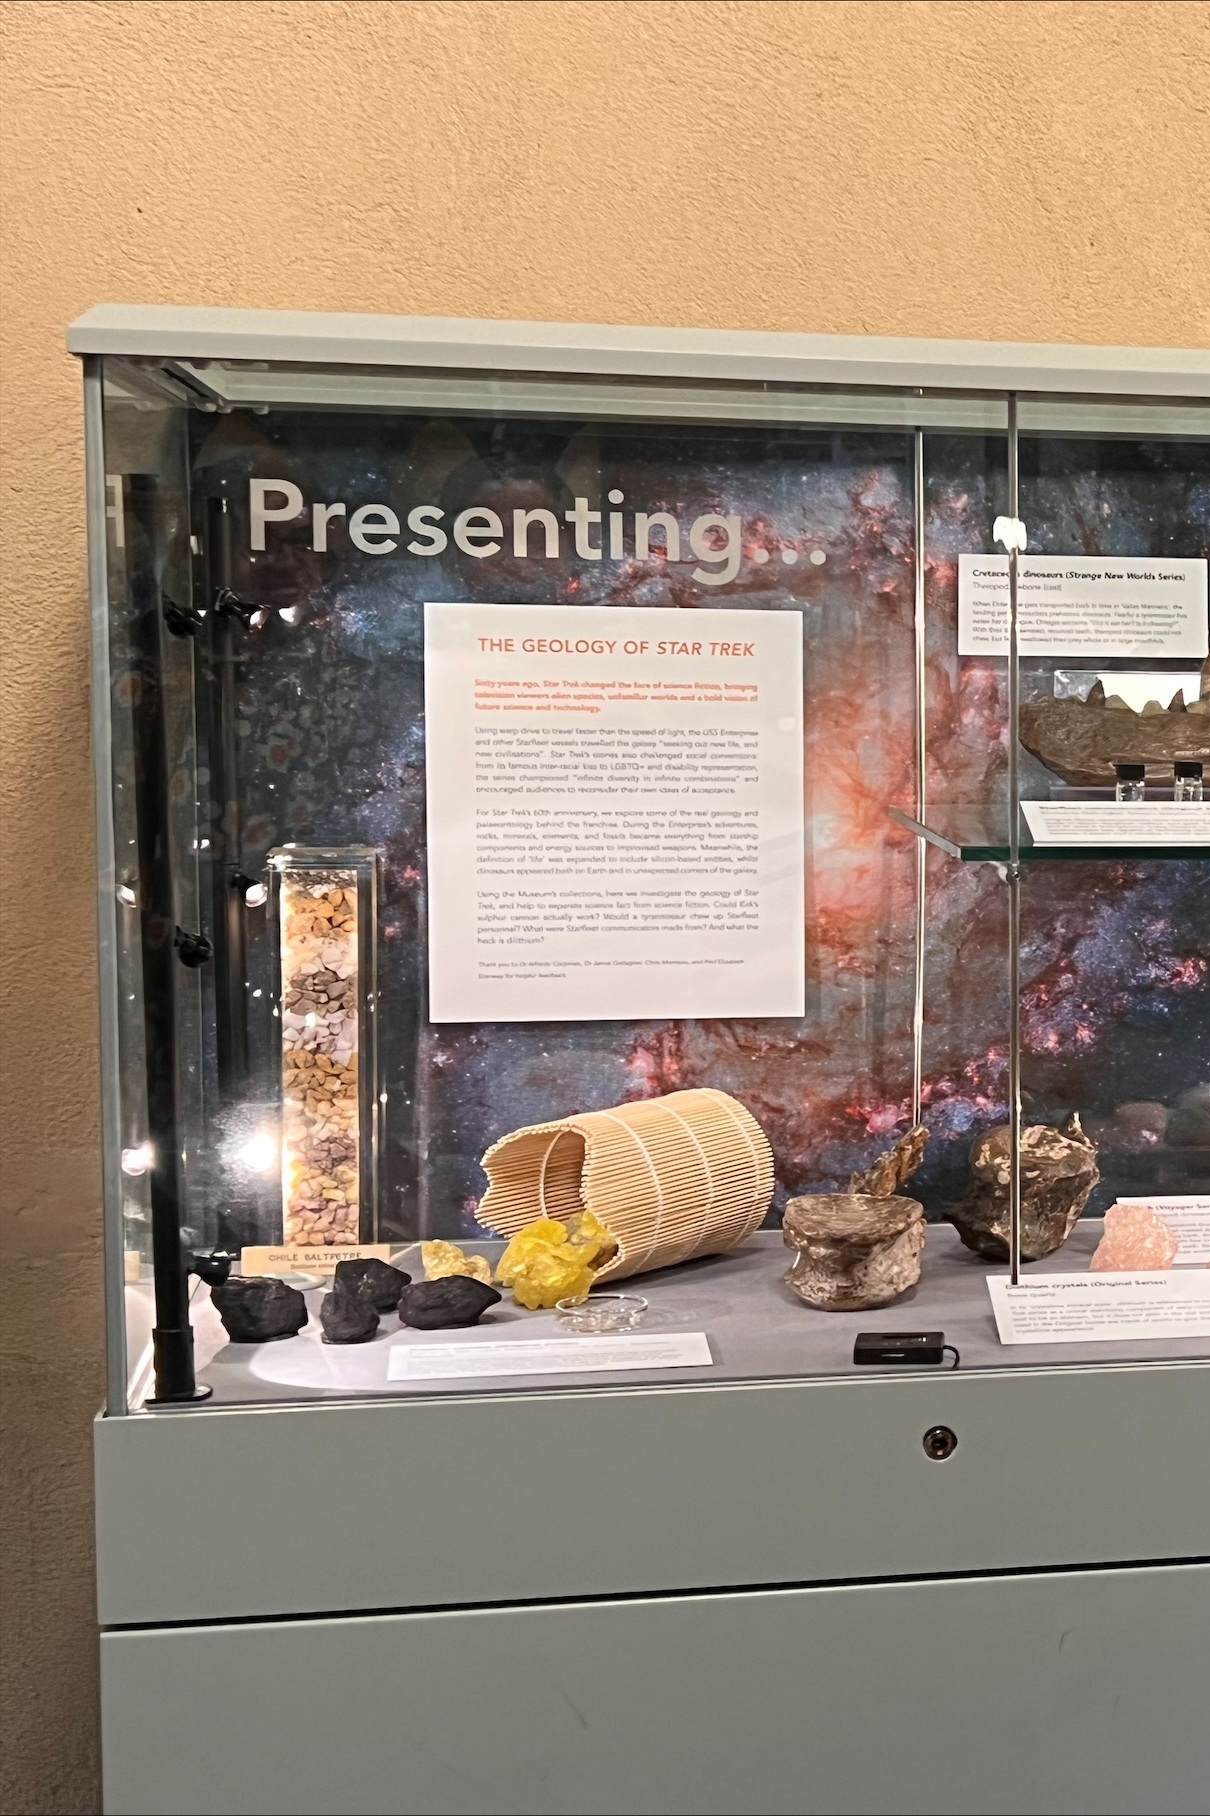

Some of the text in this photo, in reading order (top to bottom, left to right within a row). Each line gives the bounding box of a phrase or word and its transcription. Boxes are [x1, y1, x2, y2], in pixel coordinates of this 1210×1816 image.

[248, 478, 827, 585] Presenting...
[1023, 570, 1063, 579] dinosaurs
[1066, 571, 1102, 581] (Strange
[1105, 572, 1124, 580] New
[1127, 572, 1155, 580] Worlds
[1158, 572, 1186, 581] Series)
[477, 637, 755, 656] THE GEOLOGY OF STAR TREK
